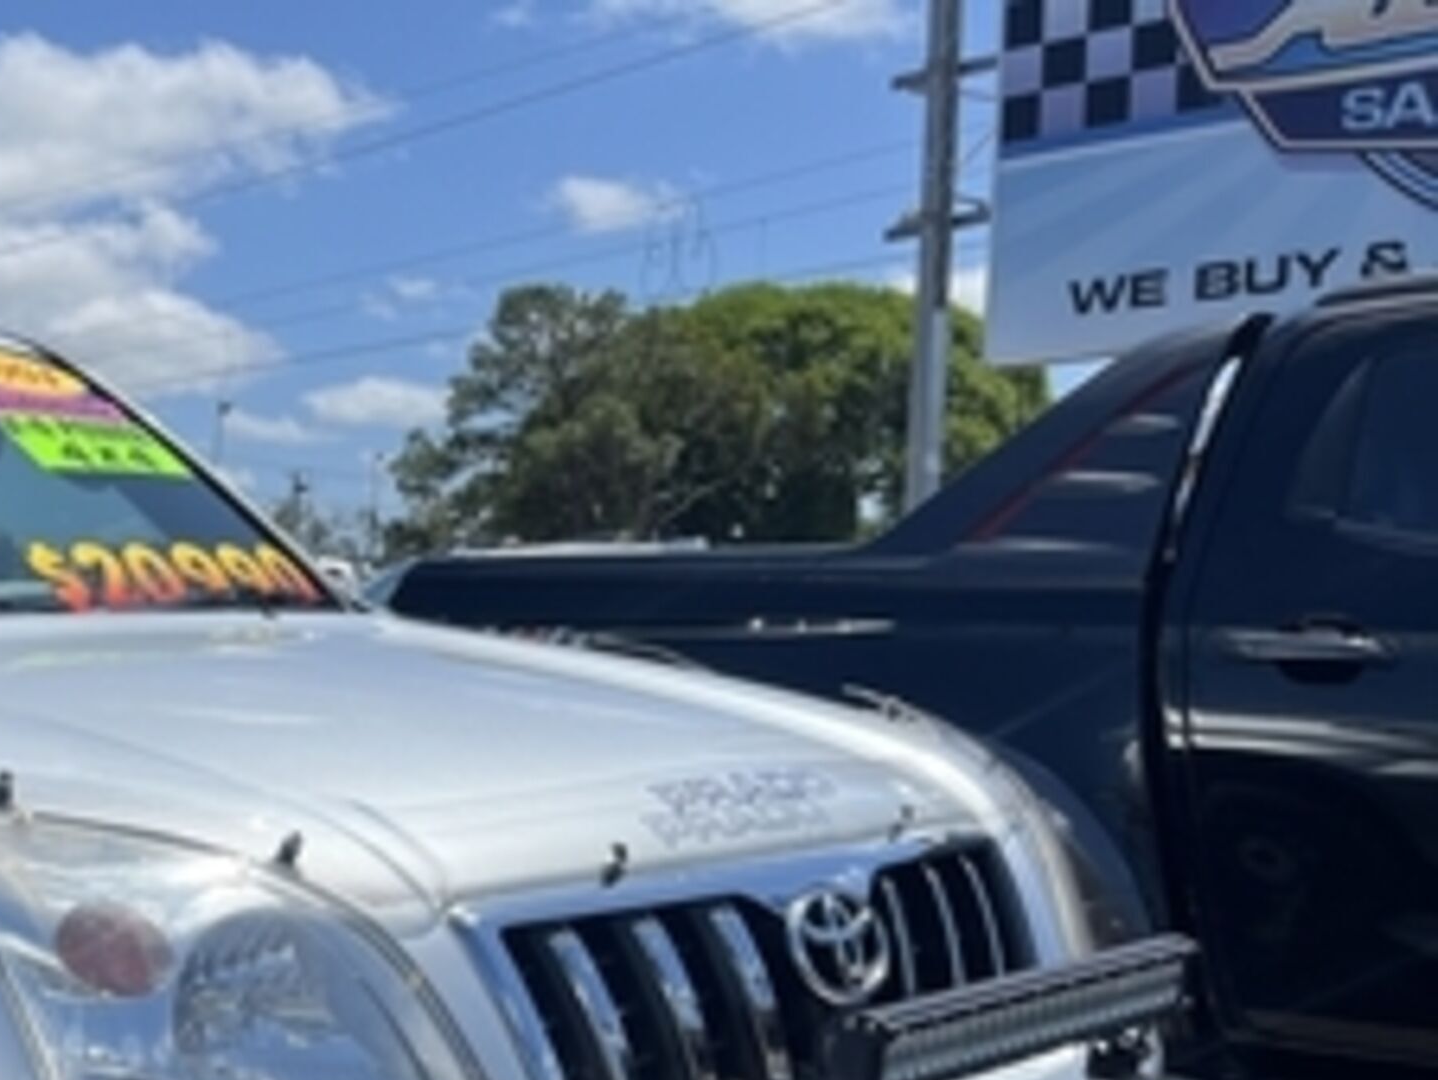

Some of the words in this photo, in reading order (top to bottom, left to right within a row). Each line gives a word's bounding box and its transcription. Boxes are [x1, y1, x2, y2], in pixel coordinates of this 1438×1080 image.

[1069, 269, 1168, 313] WE
[1194, 248, 1339, 302] BUY
[1362, 241, 1406, 277] &
[28, 540, 320, 613] $20990
